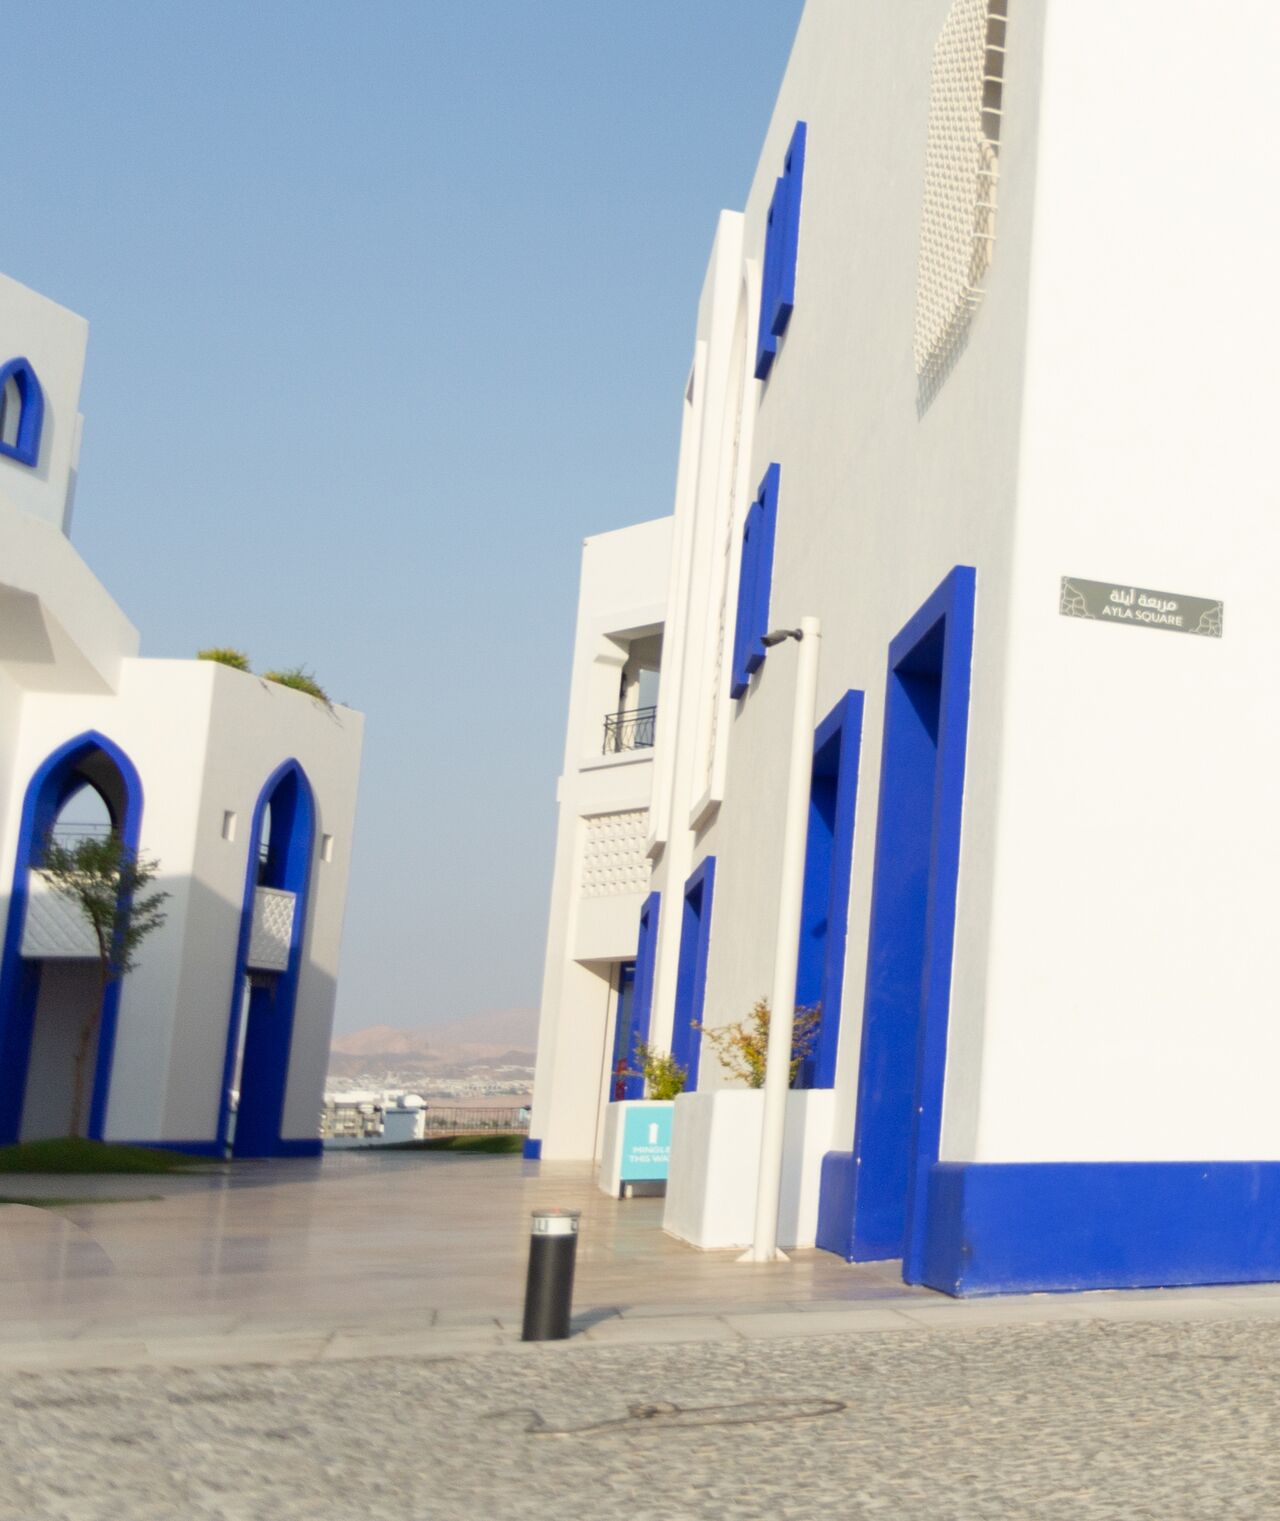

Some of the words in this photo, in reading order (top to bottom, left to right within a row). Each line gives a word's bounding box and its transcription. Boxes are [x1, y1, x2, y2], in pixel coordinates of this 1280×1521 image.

[1102, 605, 1133, 619] AYLA
[1135, 610, 1183, 627] SQUARE
[630, 1154, 651, 1163] THIS
